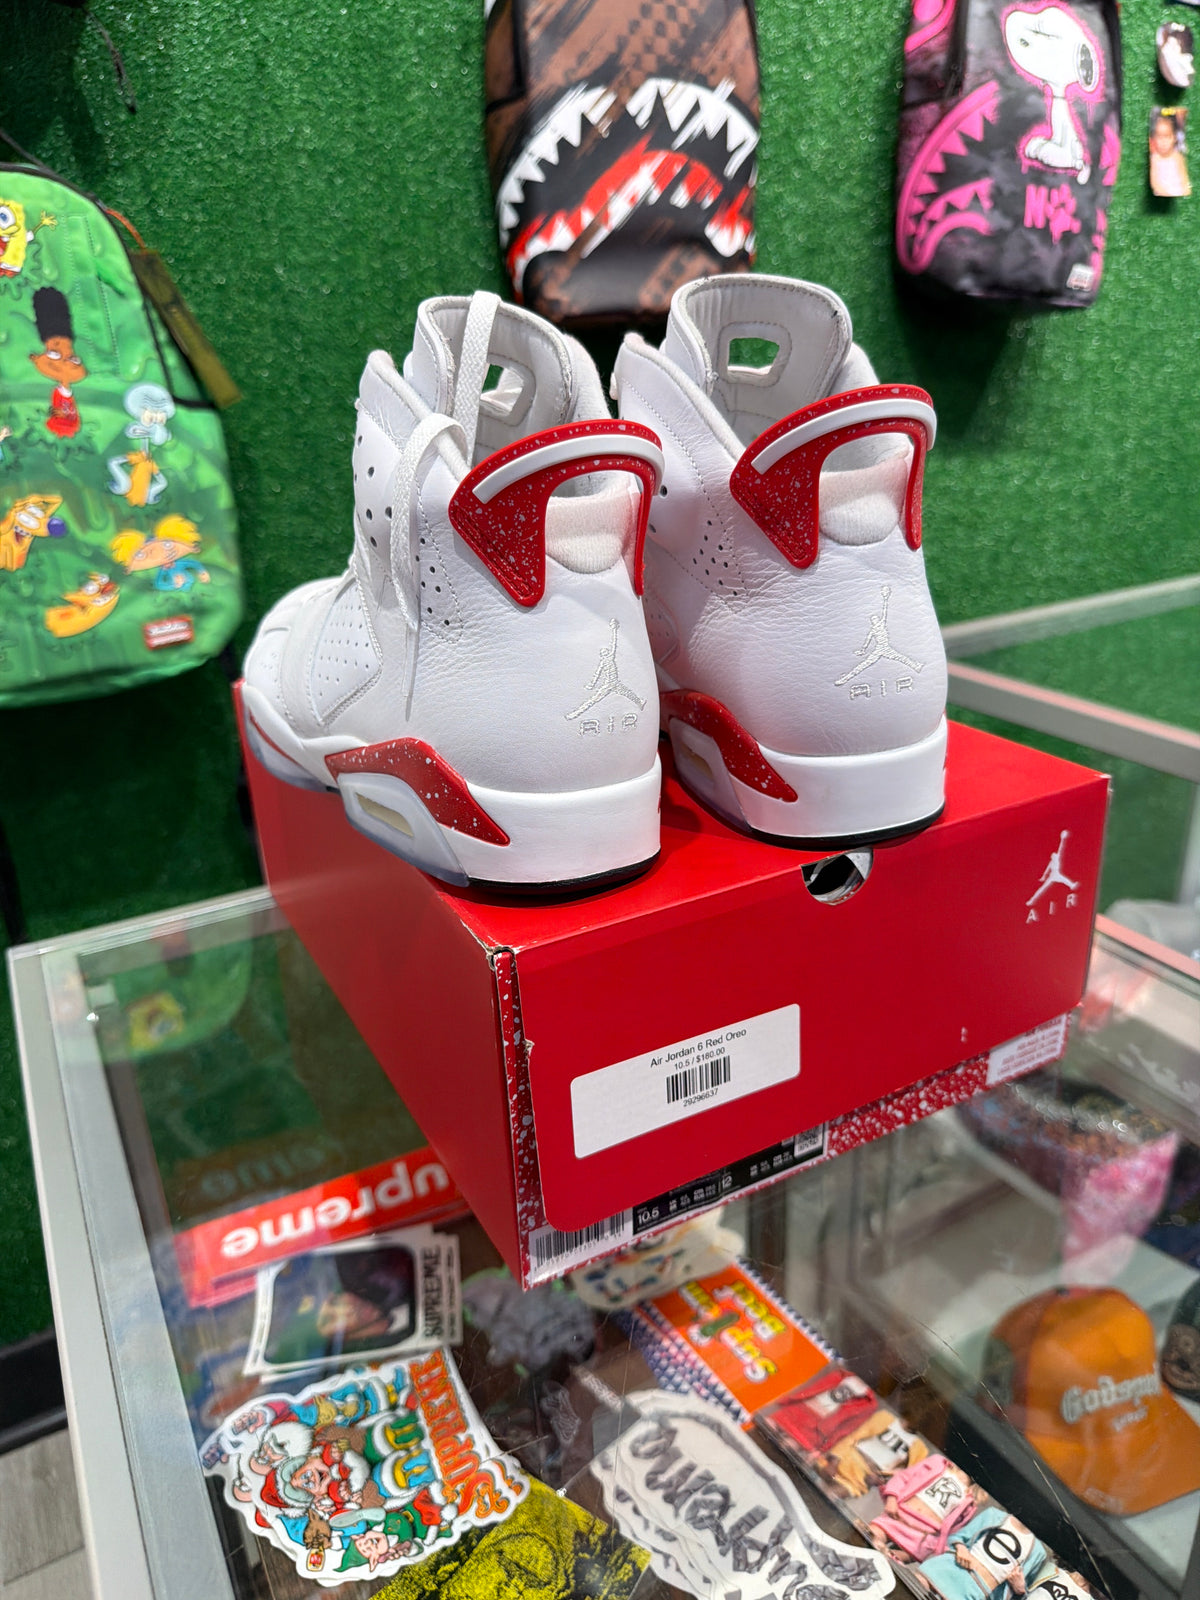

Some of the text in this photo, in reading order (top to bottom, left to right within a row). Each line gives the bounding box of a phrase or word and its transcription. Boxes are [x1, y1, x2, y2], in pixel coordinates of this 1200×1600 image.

[849, 676, 914, 700] AIR
[579, 713, 638, 736] AIR
[1026, 893, 1077, 924] AIR
[650, 1029, 747, 1068] Air Jordan 6 Red Oreo
[674, 1059, 690, 1070] 10.5
[696, 1046, 726, 1063] $180.00
[683, 1088, 719, 1107] 29296637
[220, 1160, 450, 1259] upreme
[637, 1207, 660, 1224] 10.5
